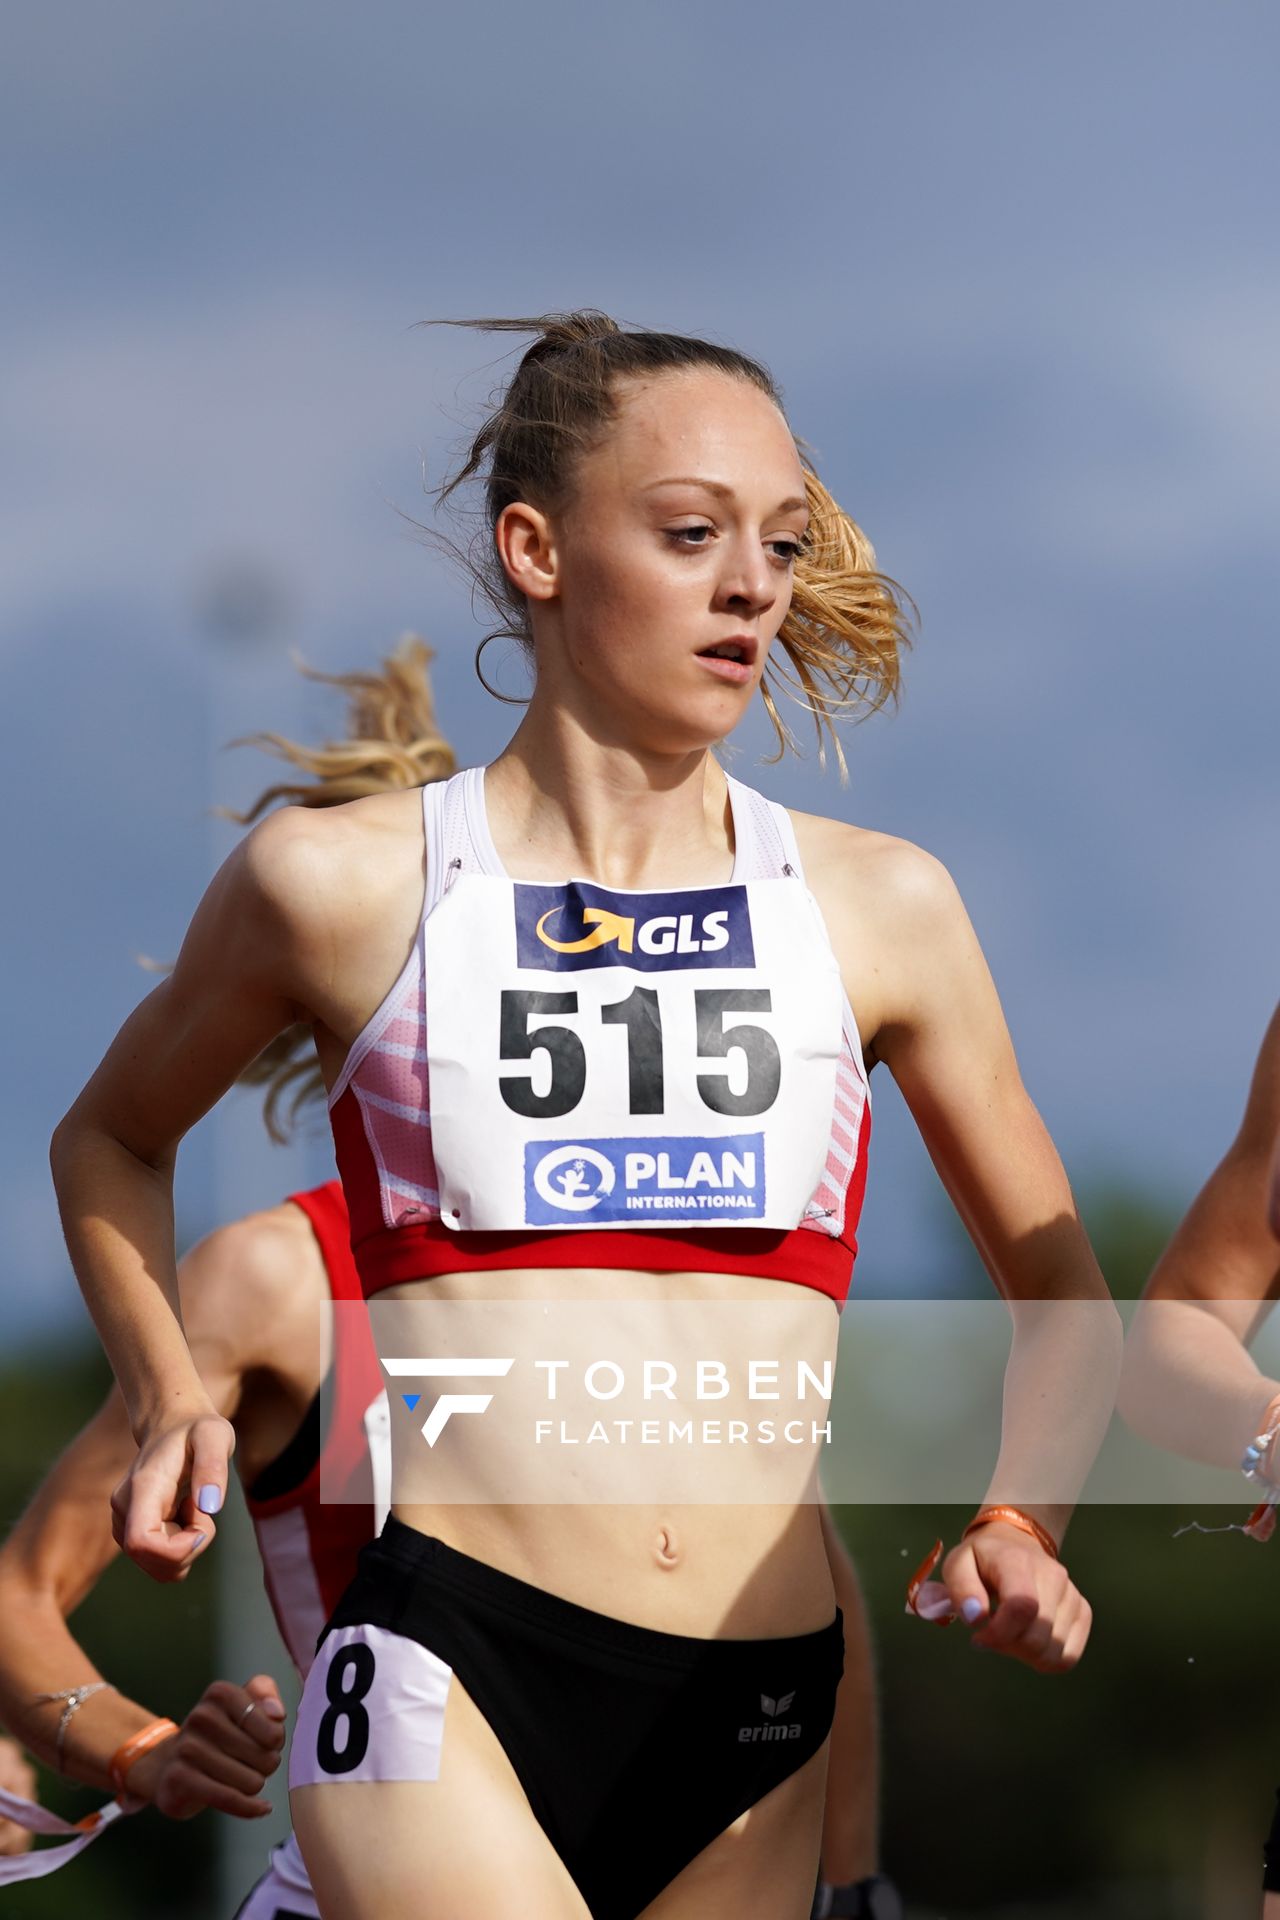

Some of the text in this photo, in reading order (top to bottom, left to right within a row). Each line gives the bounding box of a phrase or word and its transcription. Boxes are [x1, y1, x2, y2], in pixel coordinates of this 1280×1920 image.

[638, 910, 729, 955] GLS
[498, 986, 781, 1119] 515
[625, 1151, 756, 1189] PLAN
[626, 1195, 756, 1209] INTERNATIONAL
[317, 1642, 376, 1775] 8
[738, 1722, 802, 1742] erima
